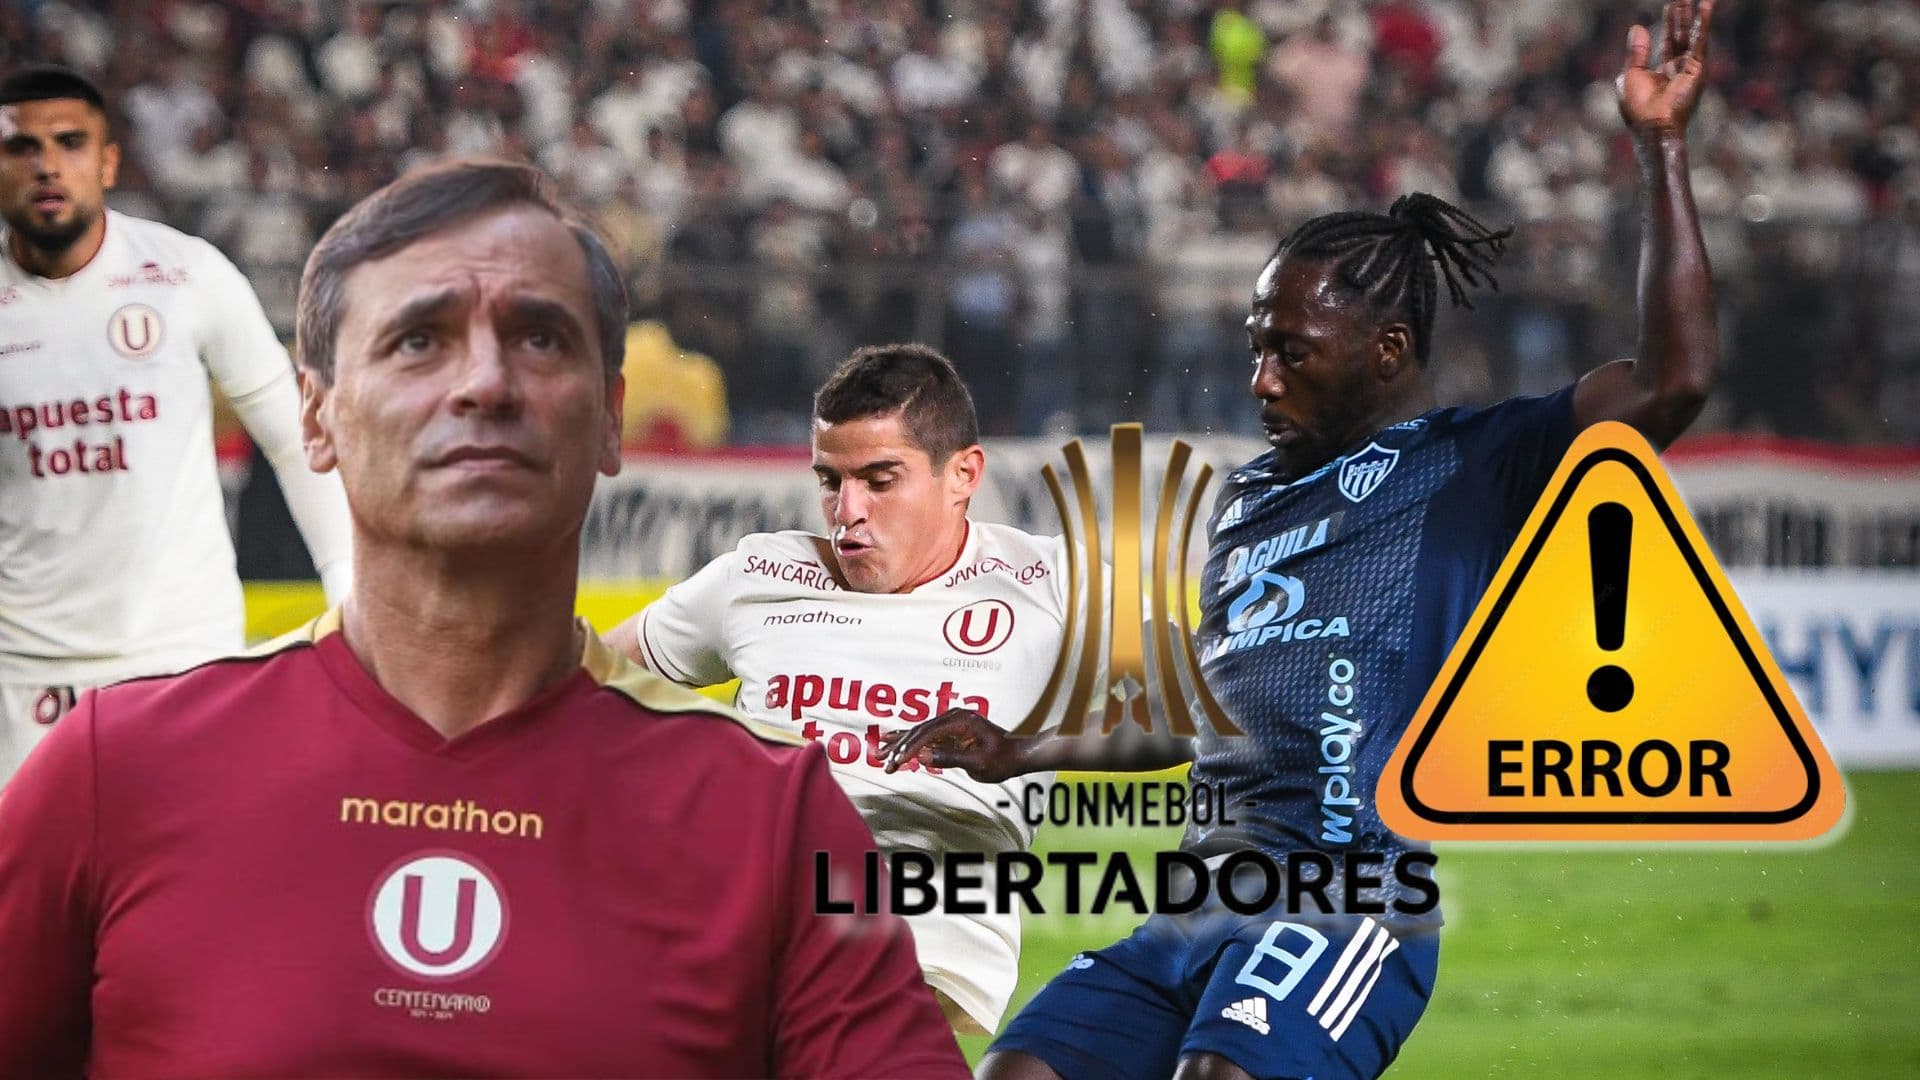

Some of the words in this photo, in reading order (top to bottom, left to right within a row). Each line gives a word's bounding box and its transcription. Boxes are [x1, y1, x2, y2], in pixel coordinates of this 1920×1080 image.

[122, 315, 150, 351] U
[29, 435, 129, 478] total
[743, 555, 781, 580] SAN
[781, 564, 837, 591] CARLO
[763, 610, 863, 627] marathon
[958, 606, 999, 647] U
[801, 720, 944, 774] tot
[1321, 656, 1363, 846] wplay.co
[339, 797, 544, 840] marathon
[400, 874, 478, 967] U
[1234, 920, 1330, 1002] 8
